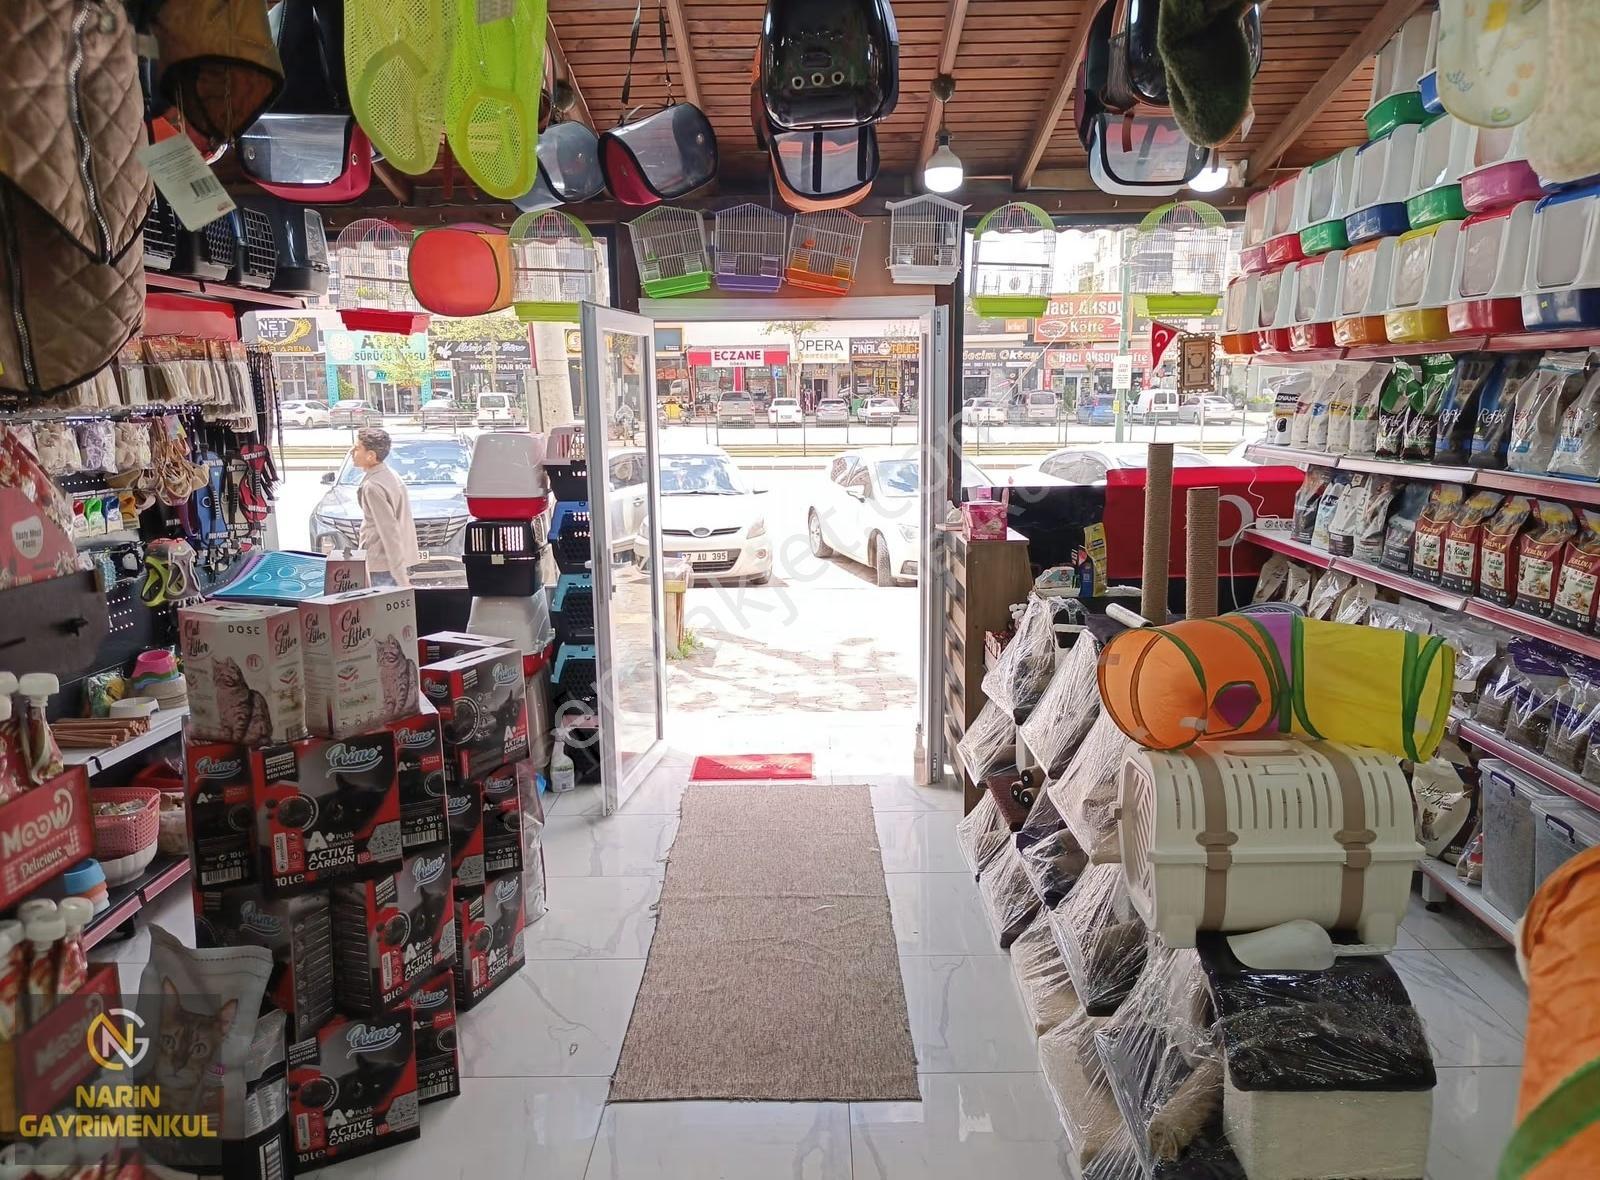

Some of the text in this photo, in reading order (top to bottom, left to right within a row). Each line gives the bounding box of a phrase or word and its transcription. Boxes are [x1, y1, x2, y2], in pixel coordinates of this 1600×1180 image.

[258, 320, 288, 331] NET
[260, 330, 288, 338] LIFE
[714, 350, 761, 361] ECZANE
[712, 552, 726, 561] 395
[334, 568, 350, 583] Cat
[305, 613, 319, 630] Cat
[341, 607, 361, 633] Cat
[227, 624, 261, 635] DOSE
[341, 626, 373, 650] Litter
[325, 742, 379, 769] Prime
[308, 844, 356, 863] ACTIVE
[307, 855, 356, 871] CARBON
[404, 949, 433, 975] ACTIVE
[404, 958, 433, 982] CARBON
[347, 1023, 397, 1048] Prime
[328, 1118, 374, 1139] ACTIVE
[328, 1128, 374, 1146] CARBON
